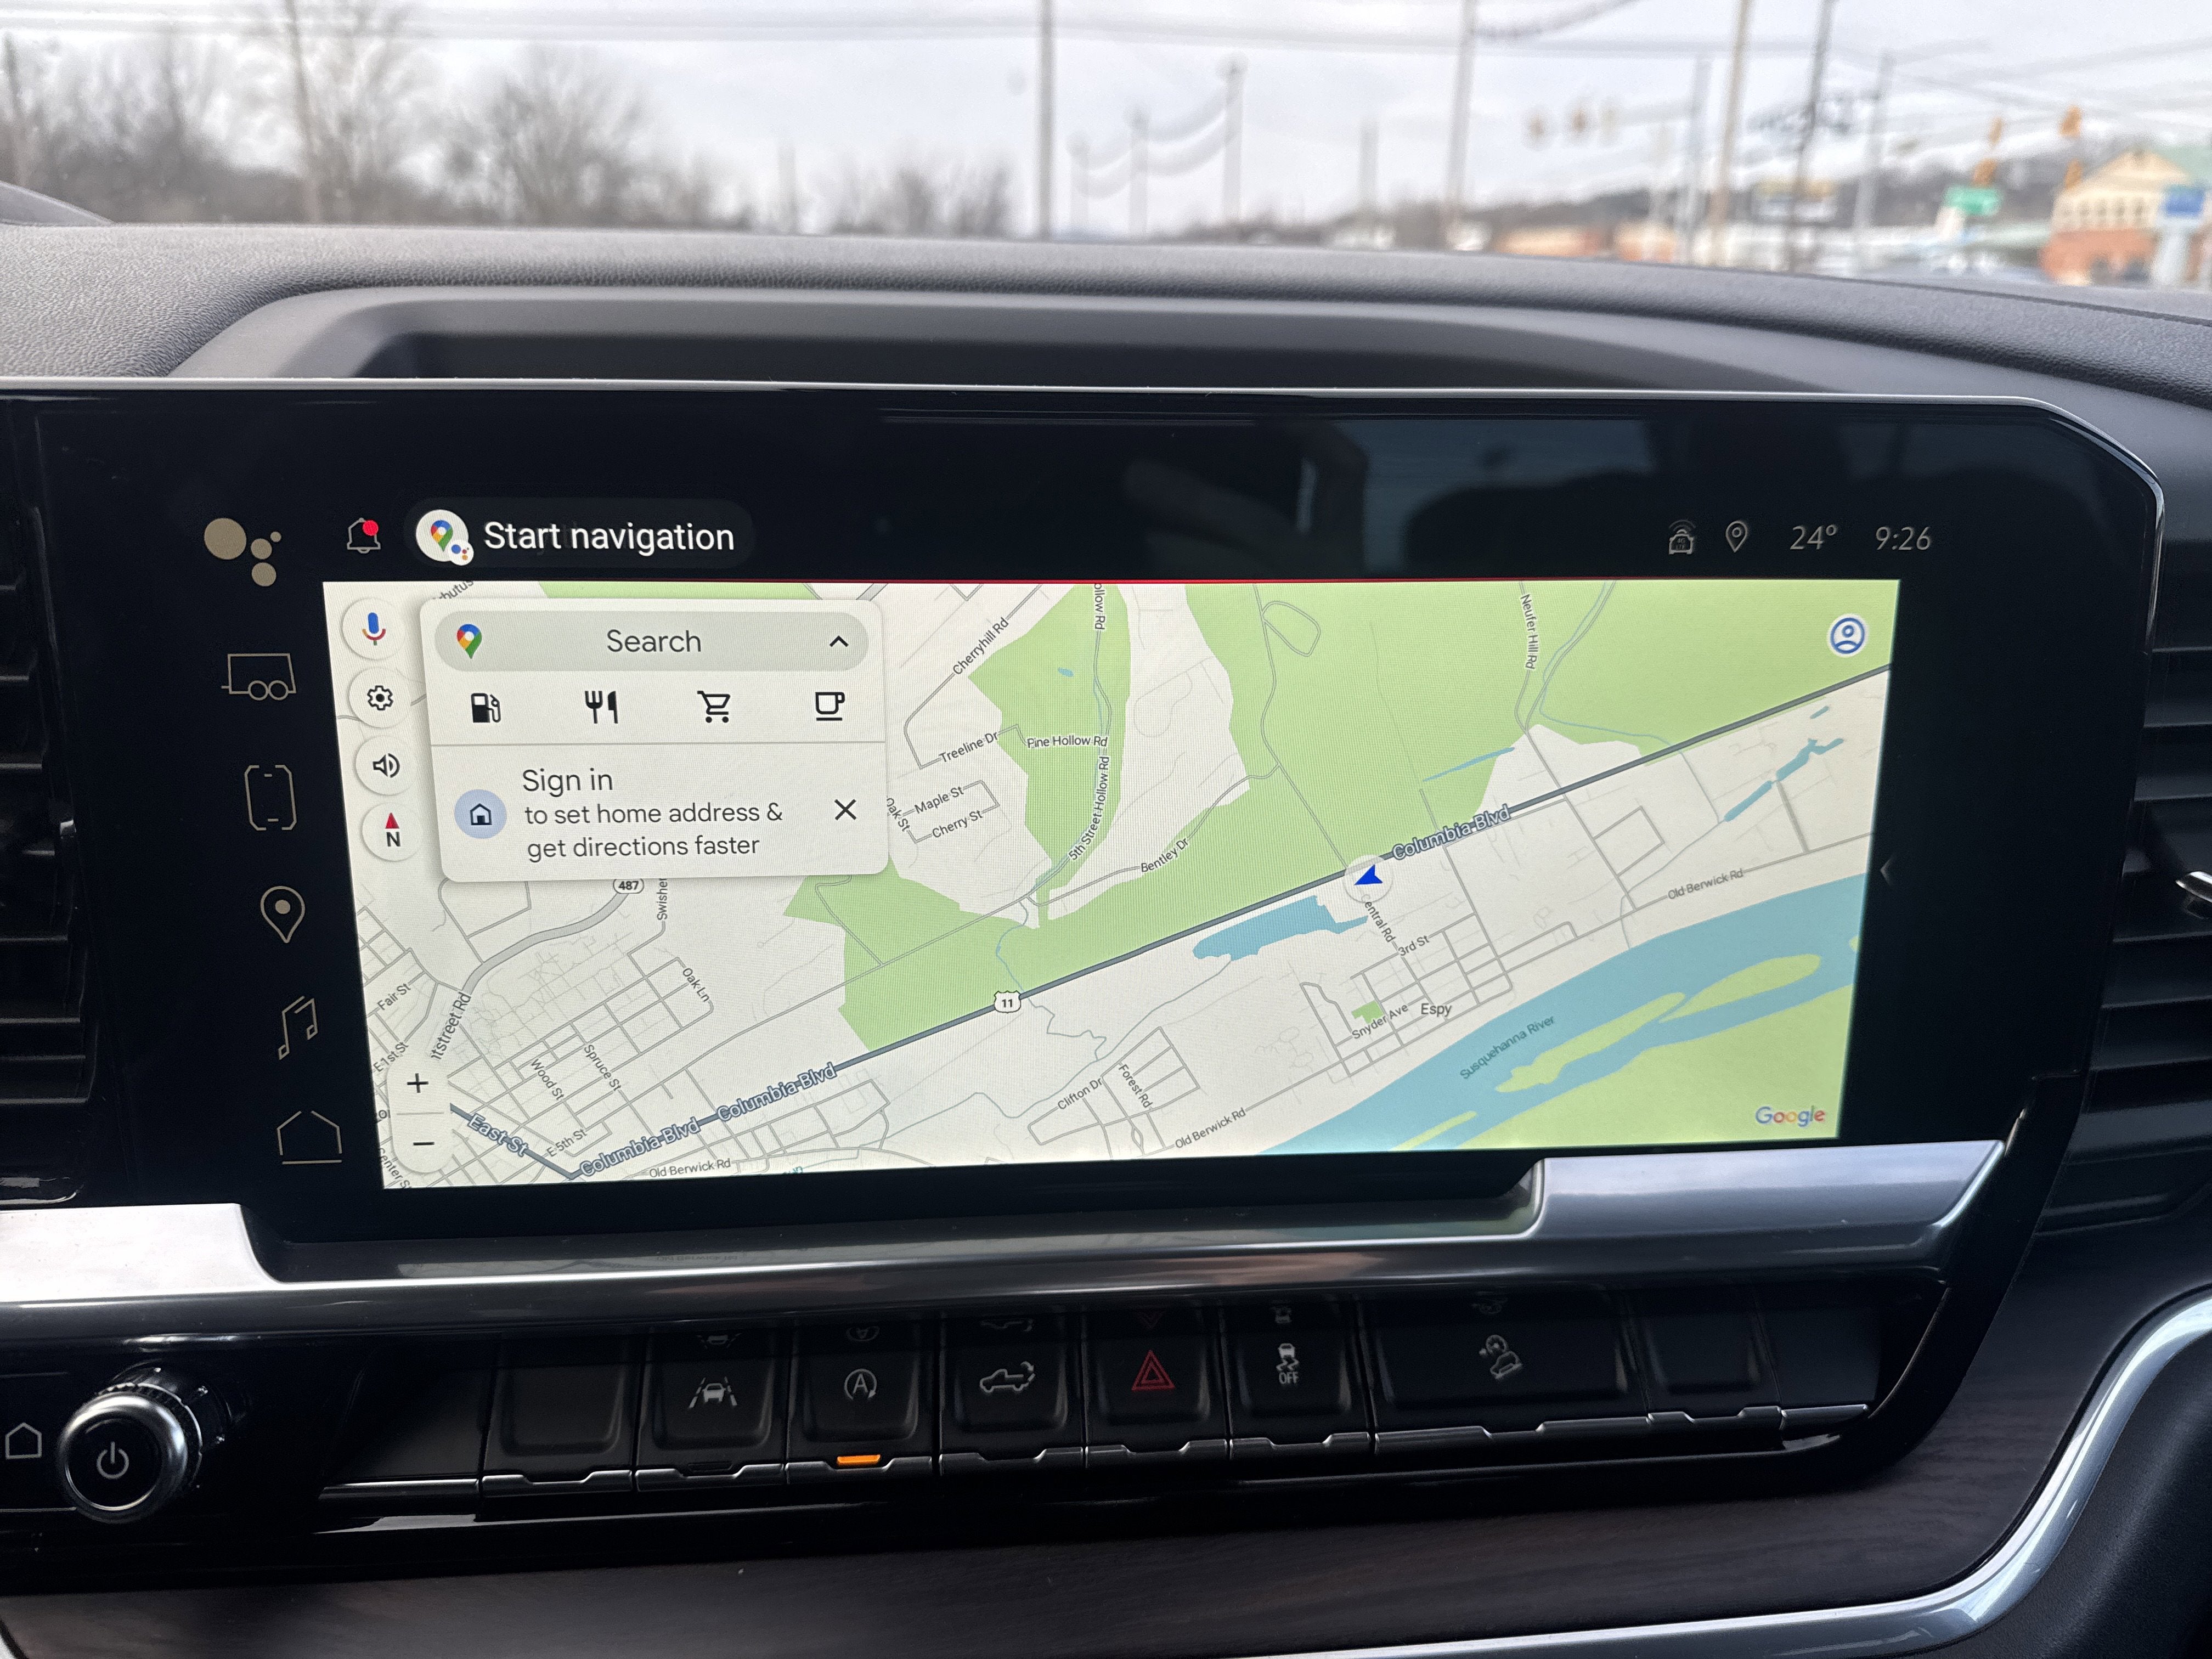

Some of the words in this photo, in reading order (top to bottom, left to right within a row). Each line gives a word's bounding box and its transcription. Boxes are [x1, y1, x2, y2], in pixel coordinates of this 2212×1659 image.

[485, 521, 560, 550] Start
[572, 522, 734, 556] navigation
[1875, 527, 1931, 550] 9:26
[1094, 616, 1105, 629] Rd
[1520, 594, 1537, 631] Neufer
[607, 629, 701, 652] Search
[953, 627, 996, 675] Cherryhill
[992, 617, 1009, 634] Rd
[1528, 635, 1538, 652] Hill
[1525, 655, 1537, 669] Rd
[940, 739, 984, 763] Treeline
[985, 732, 998, 743] Dr
[1027, 738, 1049, 748] Pine
[1053, 735, 1091, 746] Hollow
[1093, 736, 1108, 747] Rd
[1098, 757, 1109, 770] Rd
[523, 769, 581, 797] Sign
[591, 768, 613, 791] in
[1093, 773, 1108, 810] Hollow
[526, 806, 548, 824] to
[555, 804, 590, 824] set
[597, 803, 662, 823] home
[669, 802, 760, 822] address
[766, 803, 783, 821] &
[915, 794, 950, 814] Maple
[950, 787, 964, 798] St
[898, 818, 910, 832] St
[933, 817, 968, 838] Cherry
[969, 810, 983, 821] St
[1081, 814, 1102, 845] Street
[1392, 823, 1471, 861] Columbia
[1470, 803, 1511, 835] Blvd
[386, 832, 401, 847] N
[528, 840, 566, 863] get
[573, 836, 689, 857] directions
[696, 836, 760, 855] faster
[1069, 845, 1086, 860] 5th
[1141, 848, 1178, 872] Bentley
[1176, 838, 1188, 850] Dr
[618, 881, 639, 890] 487
[1668, 885, 1684, 900] Old
[1686, 874, 1728, 895] Berwick
[1729, 868, 1743, 881] Rd
[1381, 927, 1396, 943] Rd
[1398, 940, 1417, 956] 3rd
[1417, 935, 1430, 946] St
[377, 991, 398, 1011] Fair
[396, 983, 411, 996] St
[682, 968, 701, 989] Oak
[696, 986, 710, 1002] Ln
[453, 991, 472, 1011] Rd
[1002, 999, 1013, 1008] 11
[1421, 1003, 1452, 1017] Espy
[1352, 1015, 1387, 1039] Snyder
[1389, 1005, 1408, 1020] Ave
[373, 1061, 383, 1072] E
[380, 1050, 400, 1064] 1st
[395, 1041, 409, 1054] St
[1460, 1029, 1527, 1080] Susquehanna
[1525, 1015, 1555, 1037] River
[531, 1059, 557, 1088] Wood
[551, 1087, 565, 1101] St
[584, 1044, 611, 1079] Spruce
[609, 1077, 622, 1091] St
[717, 1081, 798, 1122] Columbia
[797, 1062, 837, 1090] Blvd
[1058, 1087, 1091, 1110] Clifton
[1090, 1076, 1102, 1090] Dr
[1119, 1064, 1143, 1094] Forest
[1139, 1092, 1153, 1108] Rd
[1175, 1133, 1192, 1149] Old
[1192, 1116, 1232, 1138] Berwick
[1232, 1108, 1246, 1121] Rd
[1756, 1105, 1825, 1127] Google
[467, 1113, 507, 1146] East
[506, 1136, 529, 1157] St
[547, 1147, 555, 1157] E
[555, 1136, 574, 1153] 5th
[573, 1129, 587, 1141] St
[580, 1136, 662, 1176] Columbia
[662, 1117, 700, 1144] Blvd
[650, 1169, 668, 1178] Old
[670, 1162, 715, 1176] Berwick
[716, 1159, 731, 1168] Rd
[400, 1180, 413, 1188] S
[853, 1373, 868, 1393] A
[1279, 1372, 1299, 1384] OFF
